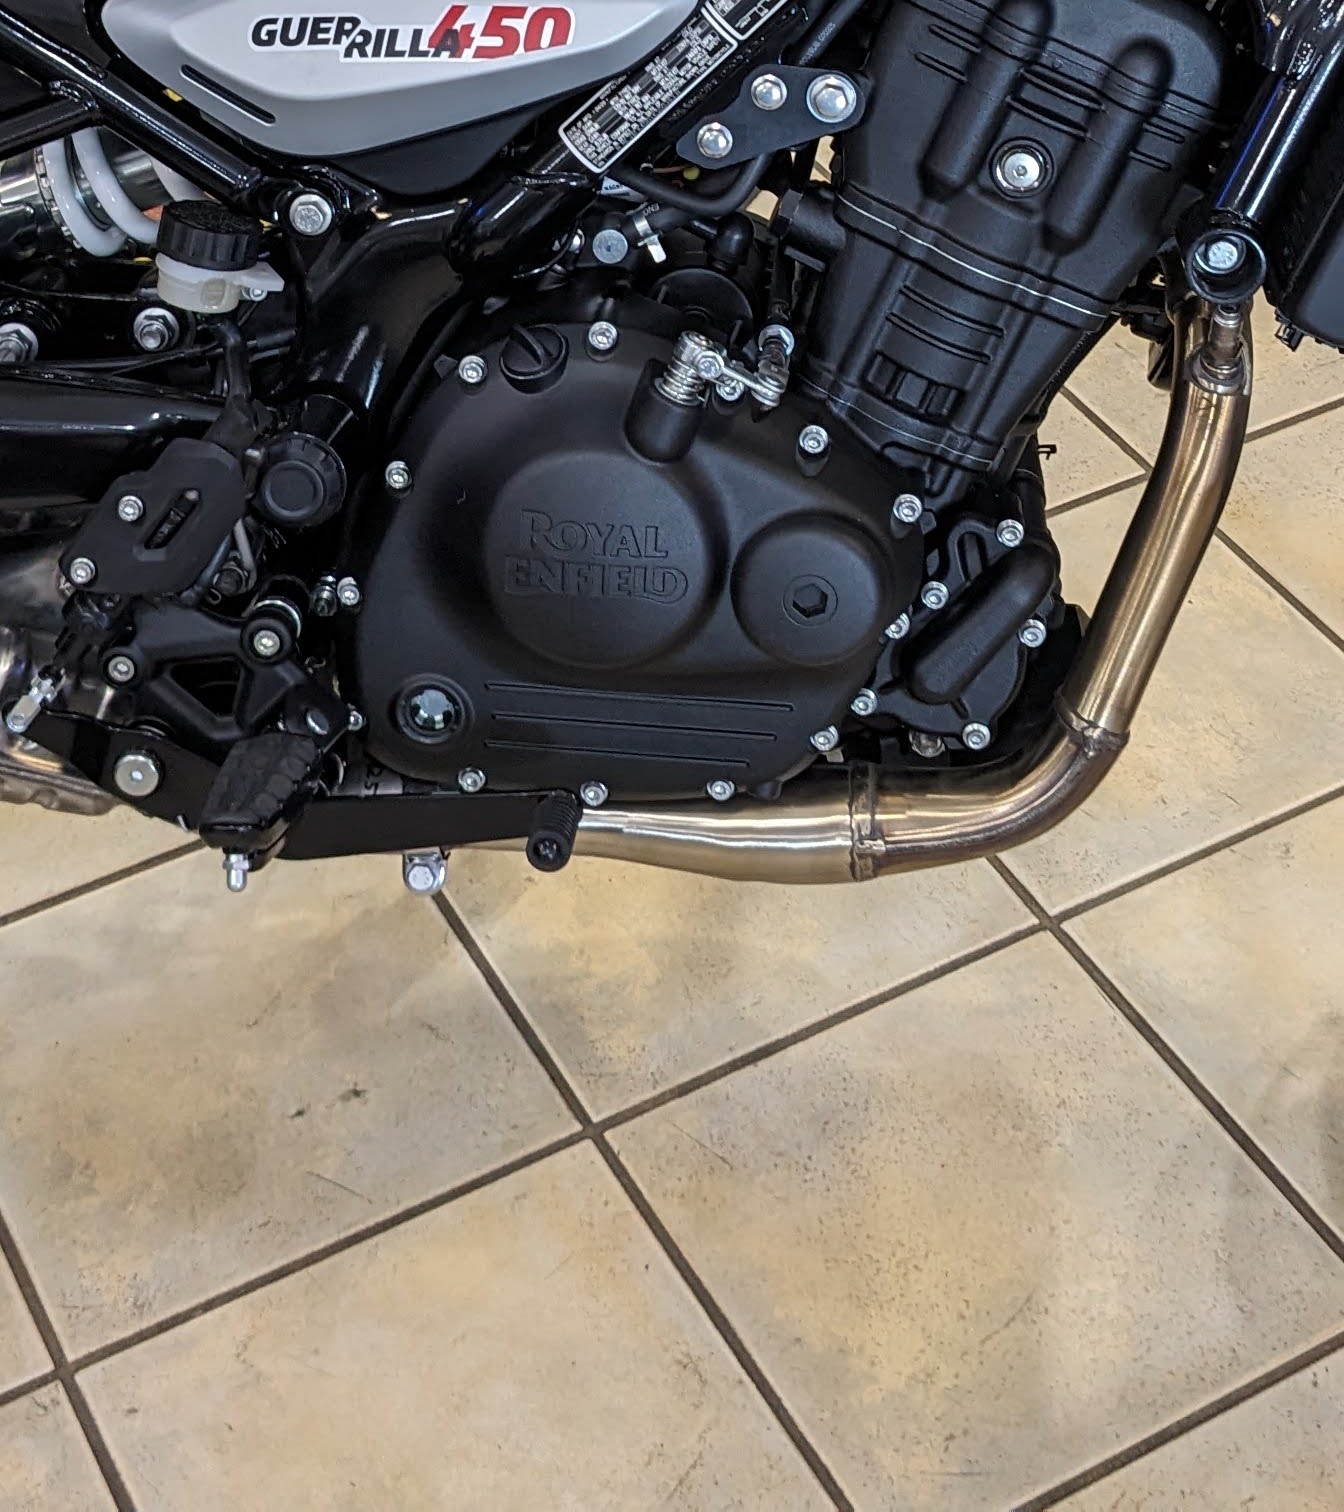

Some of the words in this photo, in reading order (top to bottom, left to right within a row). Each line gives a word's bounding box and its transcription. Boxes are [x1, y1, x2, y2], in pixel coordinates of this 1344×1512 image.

[251, 16, 463, 59] GUERRILLA
[428, 4, 573, 59] 450
[520, 508, 669, 558] ROYAL
[504, 554, 689, 605] ENFIELD
